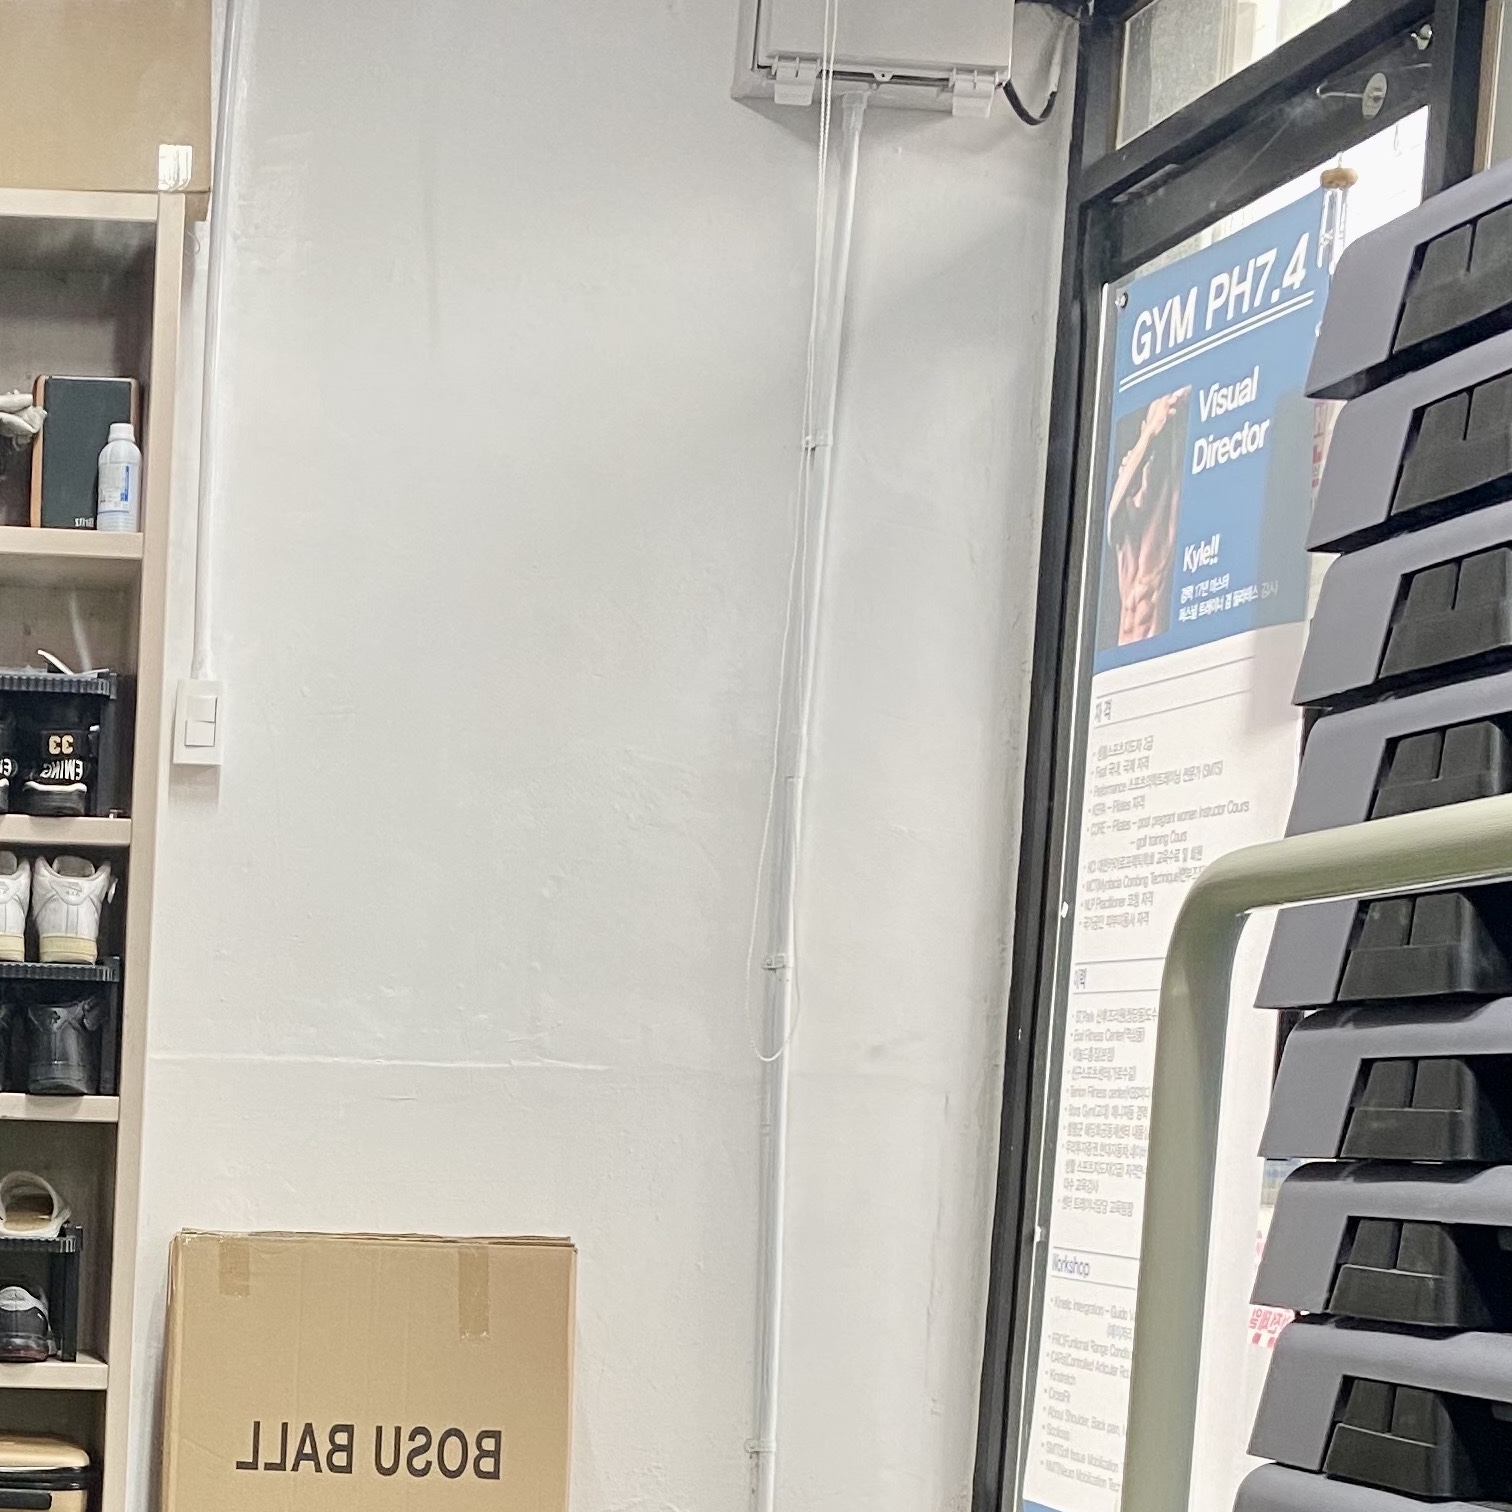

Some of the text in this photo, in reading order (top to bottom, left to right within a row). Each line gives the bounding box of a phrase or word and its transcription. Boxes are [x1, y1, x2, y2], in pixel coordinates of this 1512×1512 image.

[1132, 231, 1310, 365] GYM PH7.4
[1198, 366, 1260, 424] Visual
[1192, 419, 1270, 475] Director
[1051, 1252, 1090, 1279] Workshop
